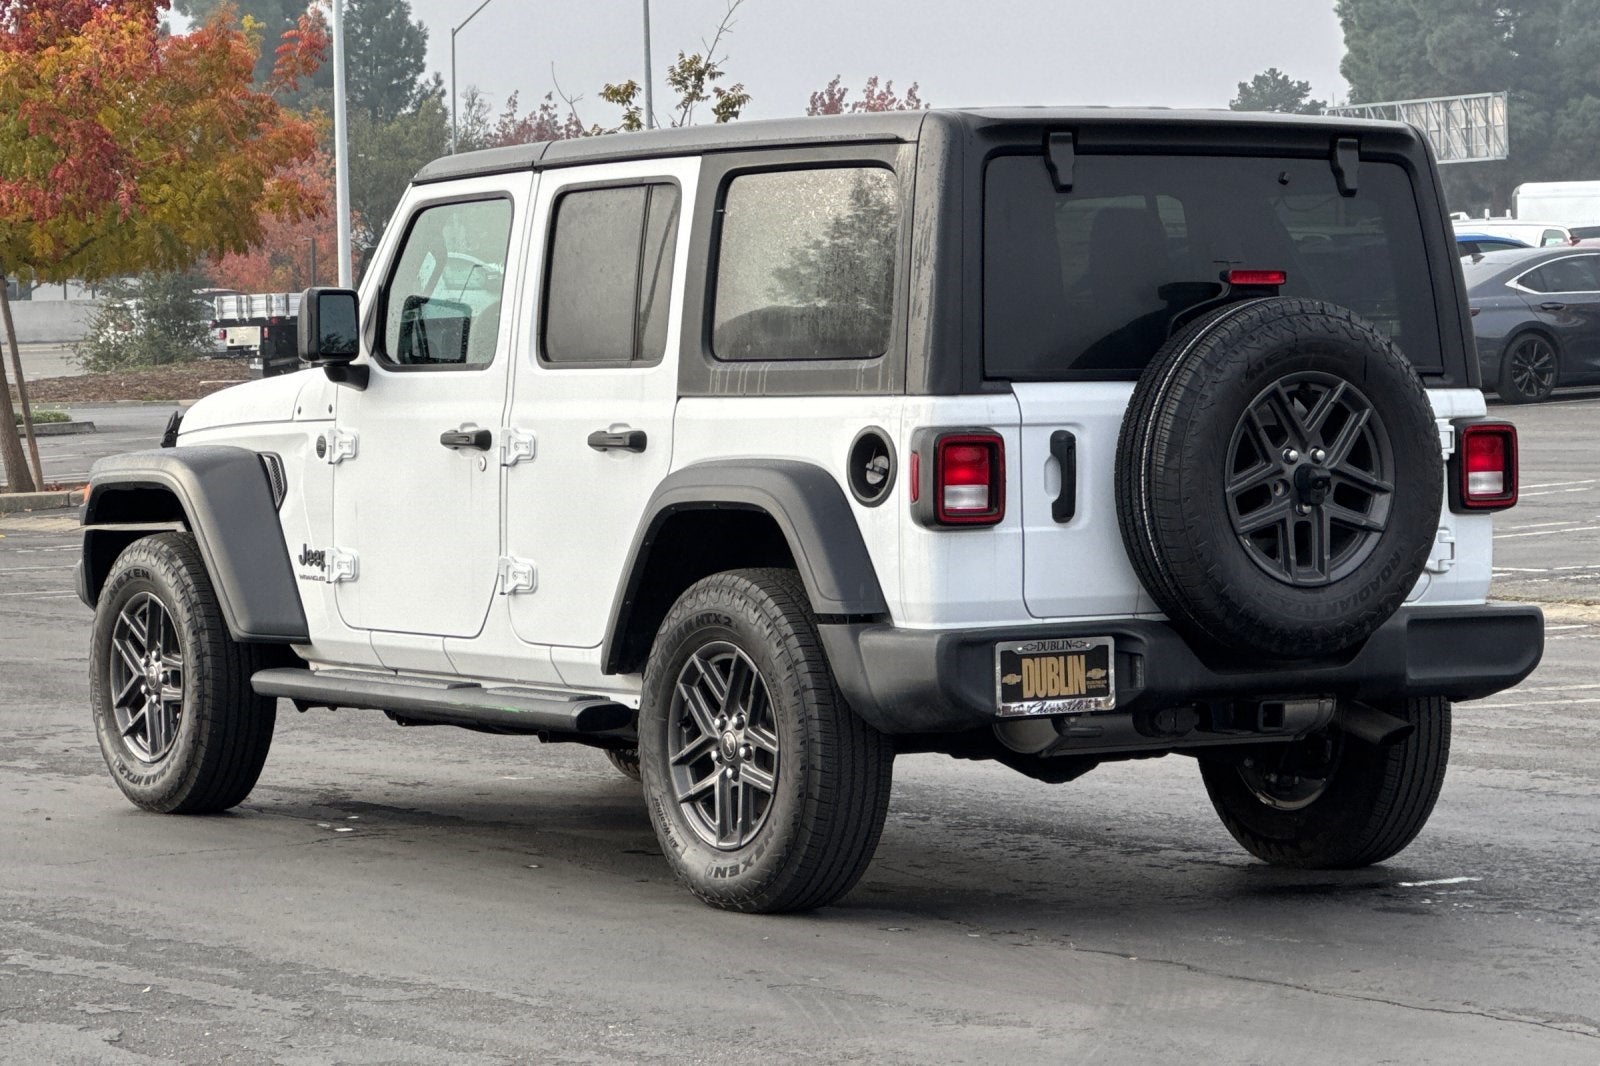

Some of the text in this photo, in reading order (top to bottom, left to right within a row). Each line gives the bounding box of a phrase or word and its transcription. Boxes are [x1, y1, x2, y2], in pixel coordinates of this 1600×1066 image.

[298, 543, 326, 572] Jeep
[109, 568, 150, 603] NEXEN
[1036, 640, 1073, 652] DUBLIN
[1021, 654, 1086, 698] DUBLIN
